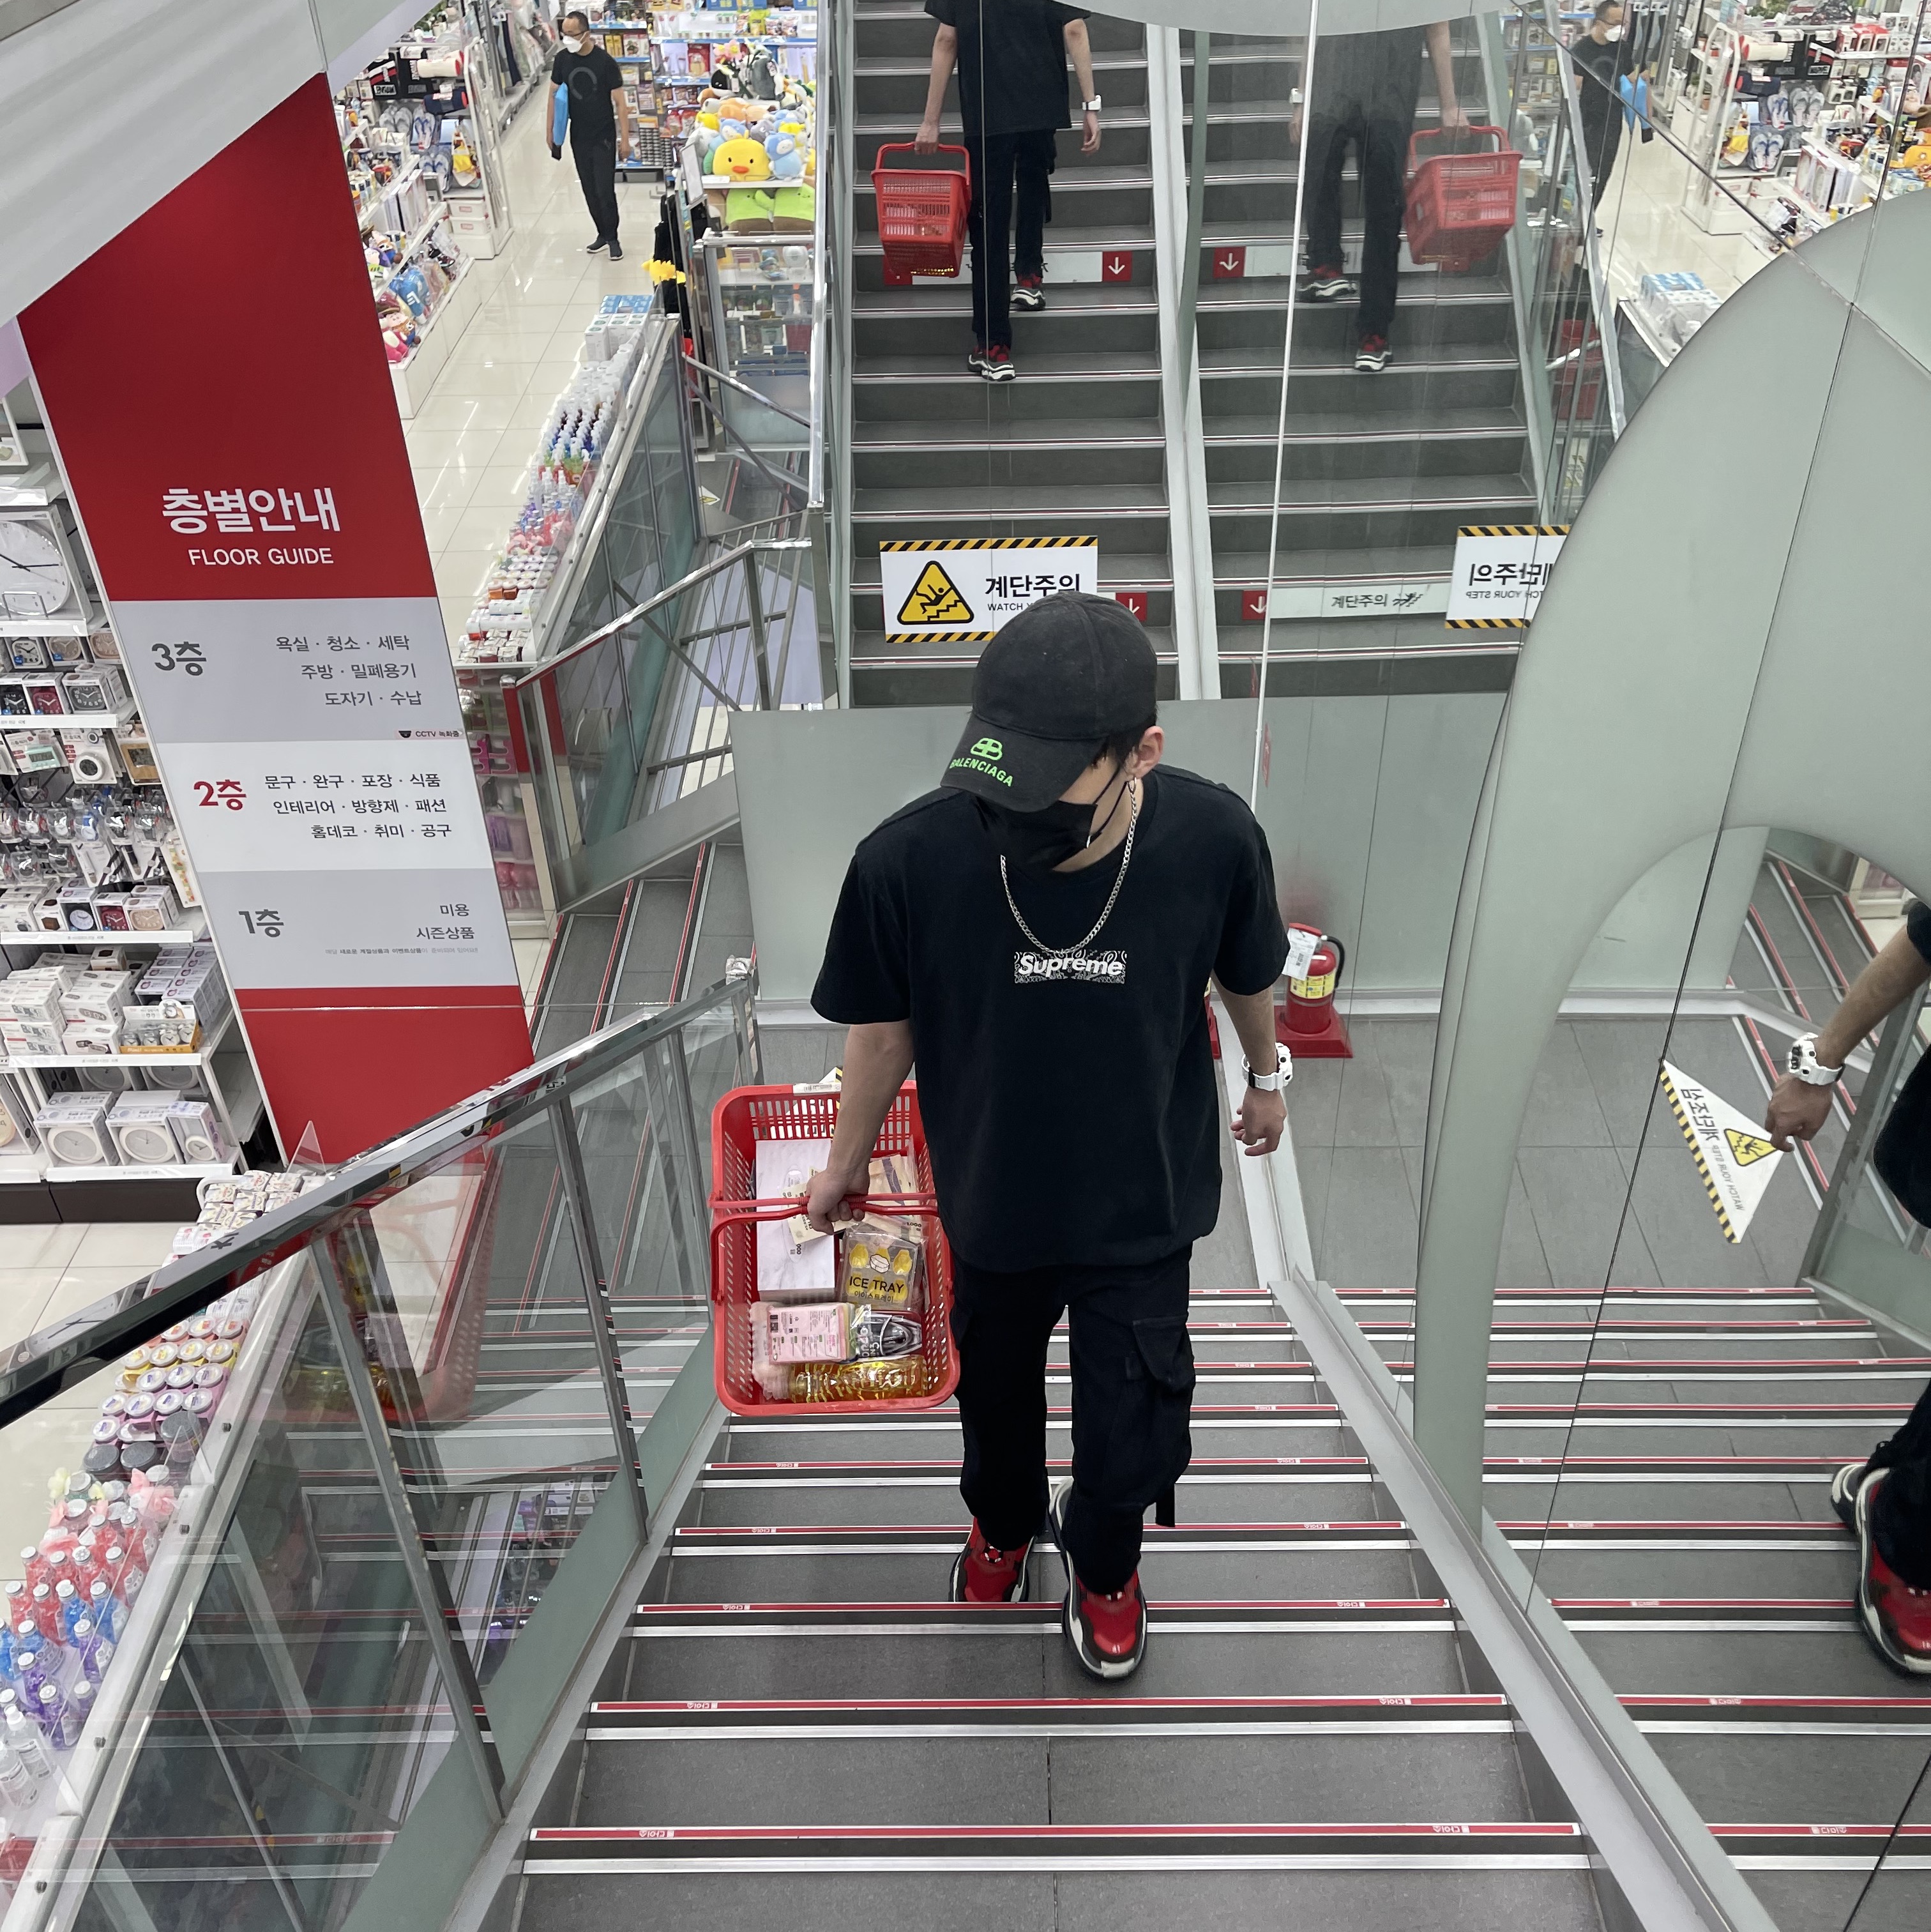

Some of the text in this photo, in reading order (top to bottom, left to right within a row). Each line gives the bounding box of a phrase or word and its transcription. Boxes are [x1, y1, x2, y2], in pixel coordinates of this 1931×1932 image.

[162, 487, 340, 534] 층별안내
[188, 547, 334, 566] FLOOR GUIDE
[985, 574, 1080, 598] 계단주의
[987, 602, 1023, 611] WATCH
[1331, 593, 1388, 609] 계단주의
[276, 635, 410, 652] 욕실 청소 세탁
[151, 641, 207, 676] 3층
[301, 662, 417, 680] 주방 밀폐용기
[324, 690, 422, 706] 도자기 수납
[264, 773, 441, 789] 문구 완구 포장 식품
[193, 779, 247, 811] 2층
[273, 798, 447, 814] 인테리어 방향제 패션
[310, 824, 452, 839] 홈데코 취미 공구
[439, 903, 470, 917] 미용
[238, 909, 285, 938] 1층
[416, 927, 475, 940] 시즌상품
[1018, 955, 1123, 977] Supreme
[849, 1276, 905, 1294] ICE TRAY
